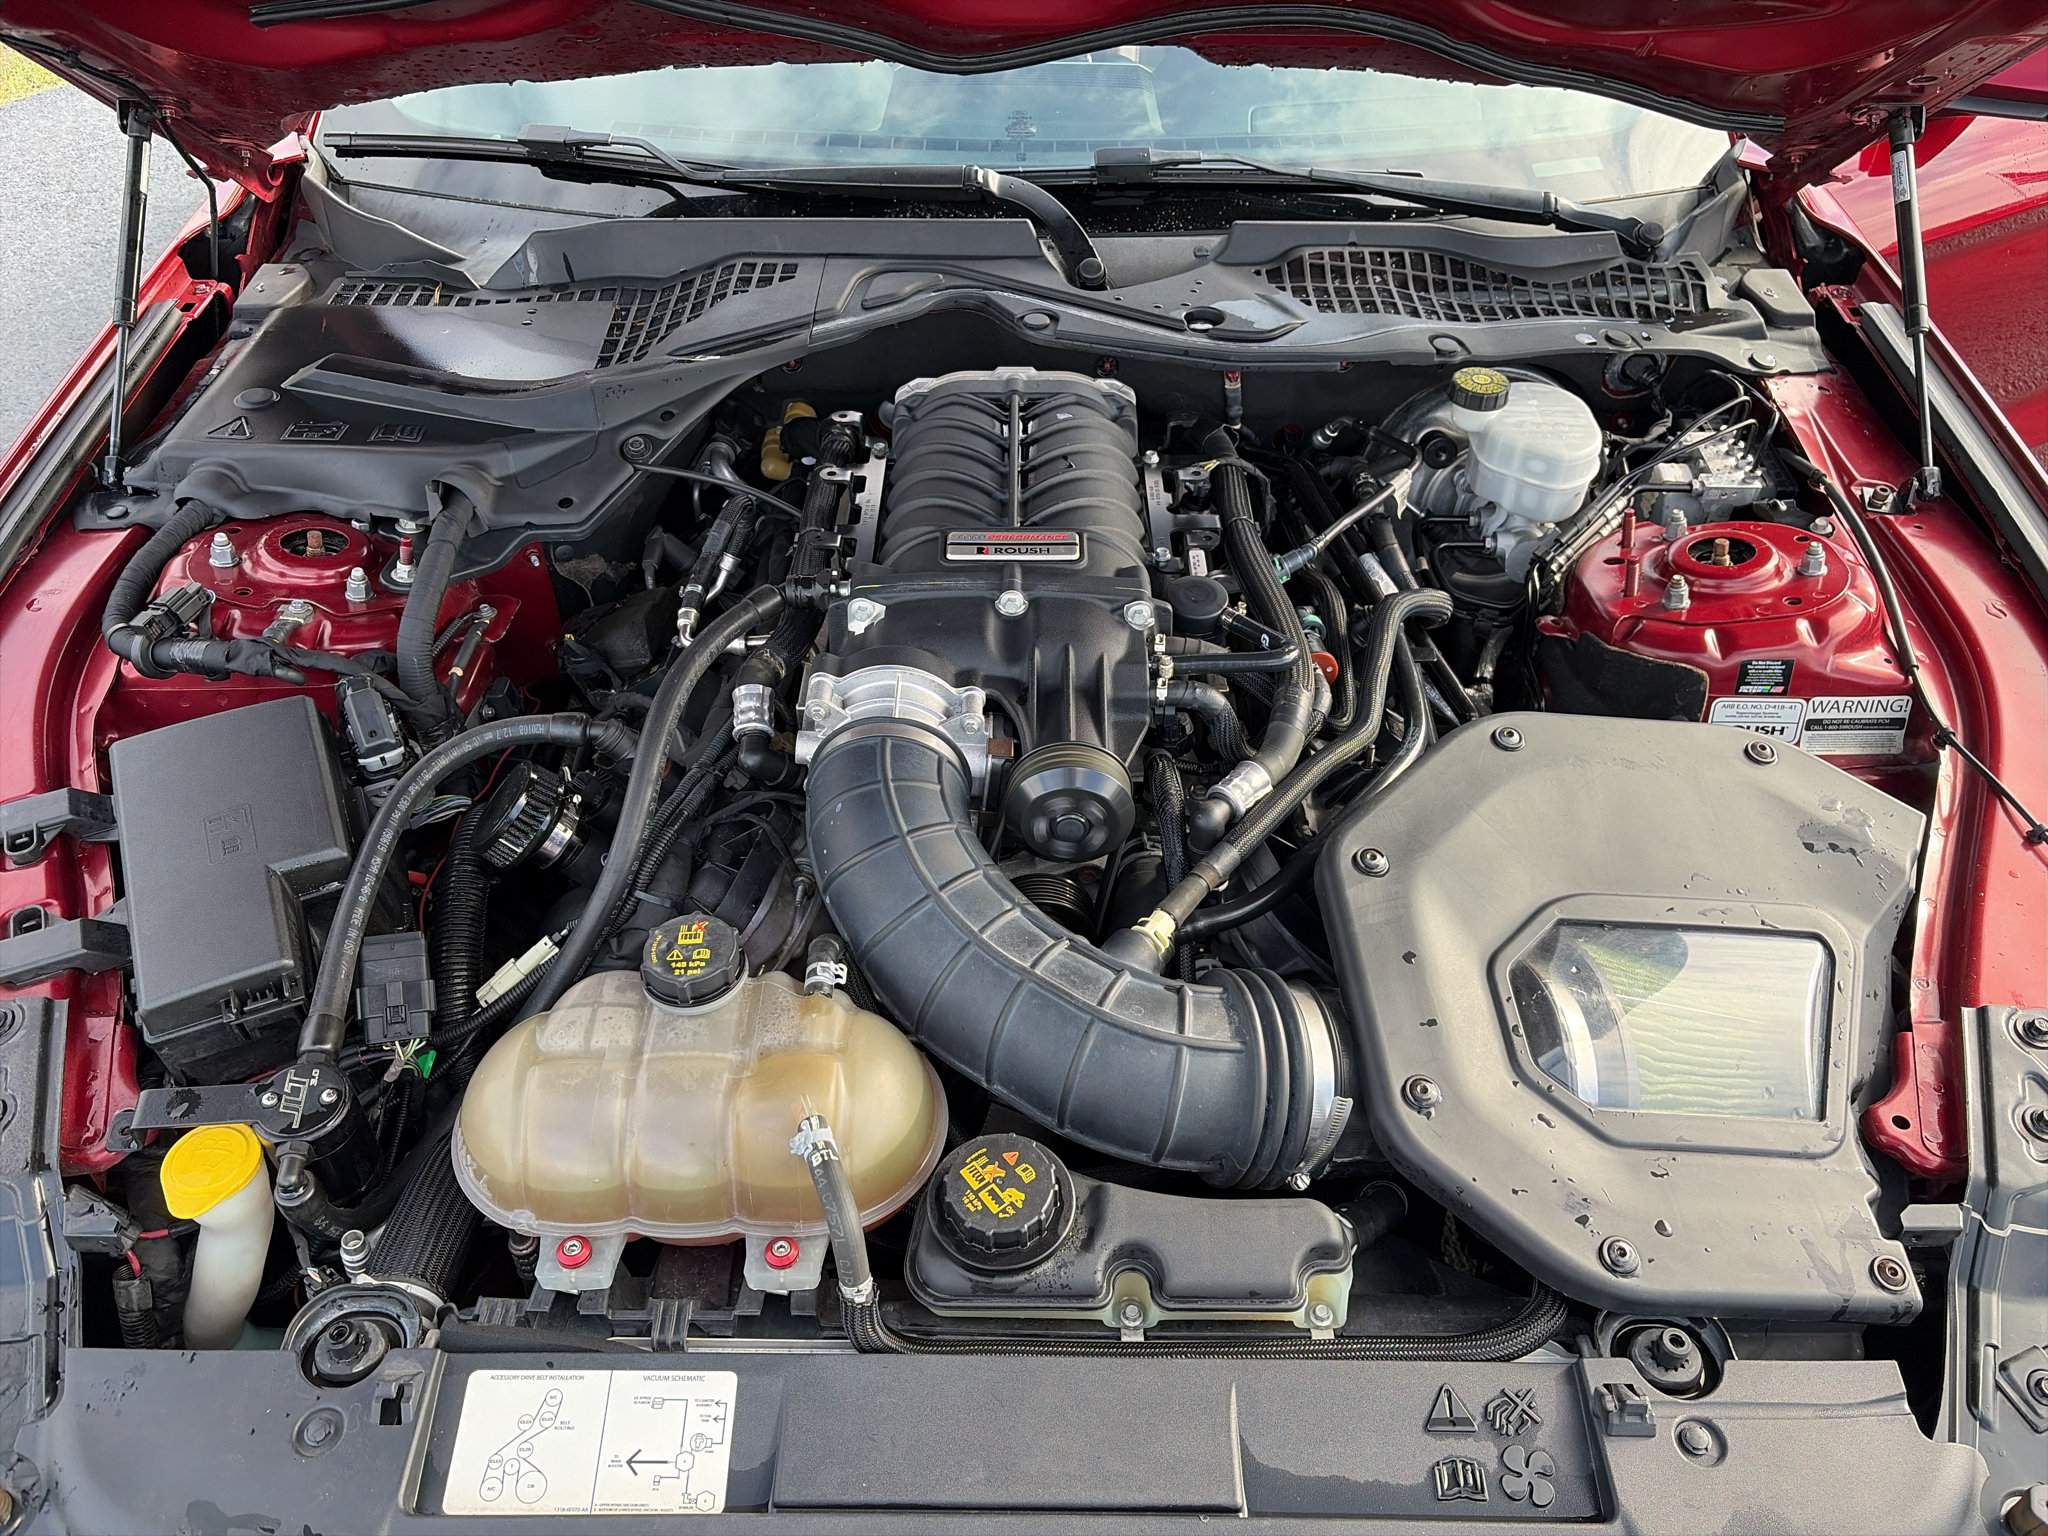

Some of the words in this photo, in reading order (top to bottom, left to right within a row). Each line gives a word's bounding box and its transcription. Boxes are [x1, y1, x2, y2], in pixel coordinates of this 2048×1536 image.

[1812, 699, 1910, 713] WARNING!
[351, 907, 364, 927] MADE
[347, 928, 358, 938] IN
[343, 939, 355, 954] USA
[310, 1069, 320, 1087] 3.0
[964, 1190, 975, 1201] 110
[1005, 1206, 1016, 1216] OK
